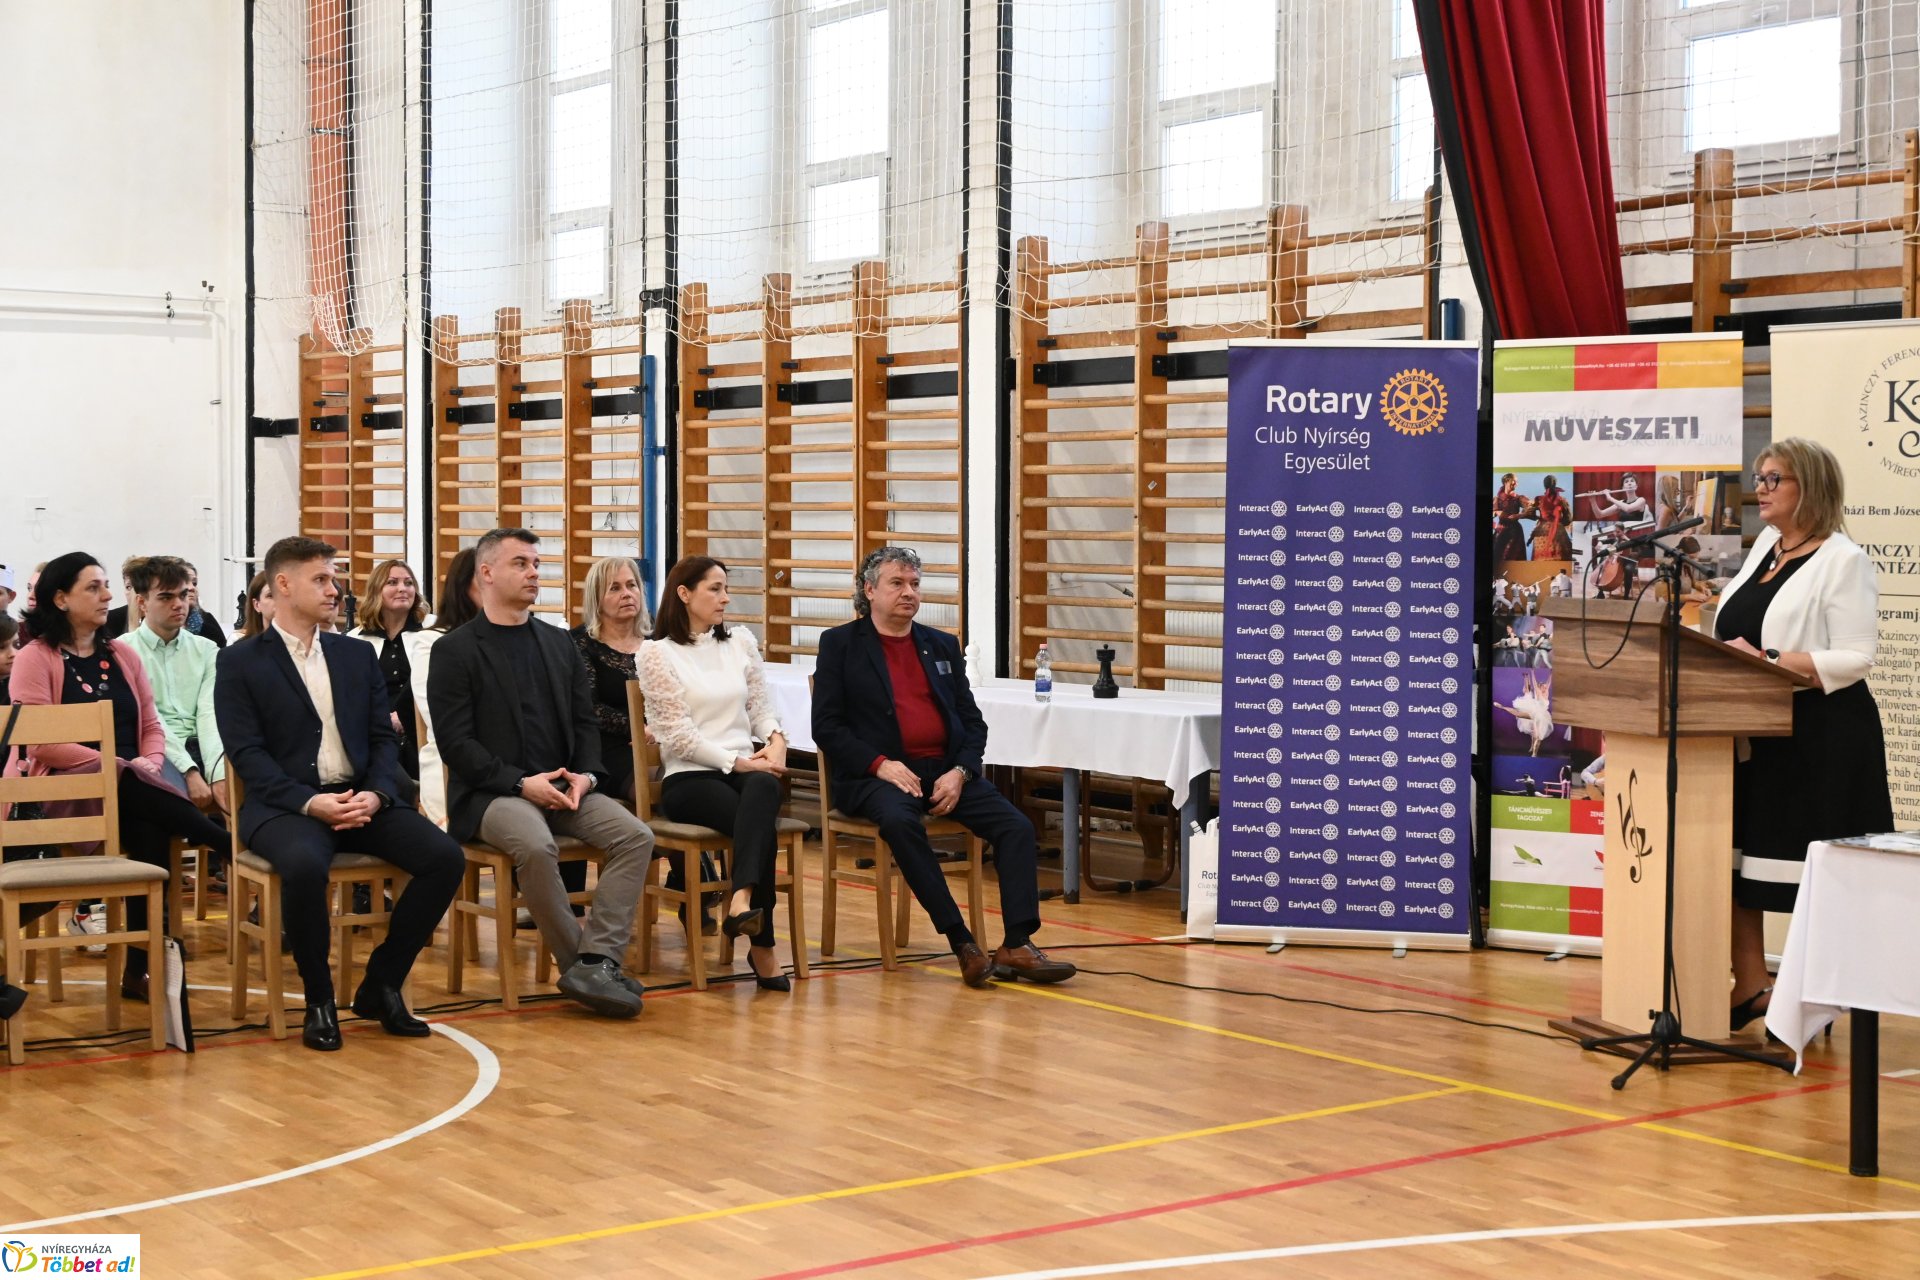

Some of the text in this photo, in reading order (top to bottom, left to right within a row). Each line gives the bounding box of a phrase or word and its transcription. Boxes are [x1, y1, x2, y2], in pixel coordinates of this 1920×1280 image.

[1400, 375, 1429, 385] ROTARY
[1266, 385, 1372, 420] Rotary
[1859, 370, 1880, 433] KAZINCZY
[1389, 410, 1438, 429] INTERNATIONAL
[1255, 426, 1370, 448] Club Nyírség
[1284, 452, 1371, 473] Egyesület
[1239, 504, 1445, 516] Interact EarlyAct Interact EarlyAct
[1868, 506, 1891, 516] Bem
[1238, 528, 1443, 540] EarlyAct Interact EarlyAct Interact
[1238, 553, 1444, 565] Interact EarlyAct Interact EarlyAct
[1872, 558, 1920, 575] NTÉZ
[1237, 577, 1442, 589] EarlyAct Interact EarlyAct Interact
[1236, 602, 1443, 615] Interact EarlyAct Interact EarlyAct
[1236, 626, 1442, 639] EarlyAct Interact EarlyAct Interact
[1877, 629, 1920, 645] Kazinczy
[1235, 651, 1442, 665] Interact EarlyAct Interact EarlyAct
[1235, 676, 1441, 689] EarlyAct Interact EarlyAct Interact
[1234, 701, 1441, 715] Interact EarlyAct Interact EarlyAct
[1234, 725, 1440, 739] EarlyAct Interact EarlyAct Interact
[1233, 750, 1440, 765] Interact EarlyAct Interact EarlyAct
[1894, 766, 1911, 778] báb
[1233, 774, 1439, 789] EarlyAct Interact EarlyAct Interact
[1232, 800, 1439, 815] Interact EarlyAct Interact EarlyAct
[1232, 824, 1438, 839] EarlyAct Interact EarlyAct Interact
[1231, 849, 1438, 865] Interact EarlyAct Interact EarlyAct
[1231, 873, 1437, 890] EarlyAct Interact EarlyAct Interact
[1230, 899, 1437, 915] Interact EarlyAct Interact EarlyAct
